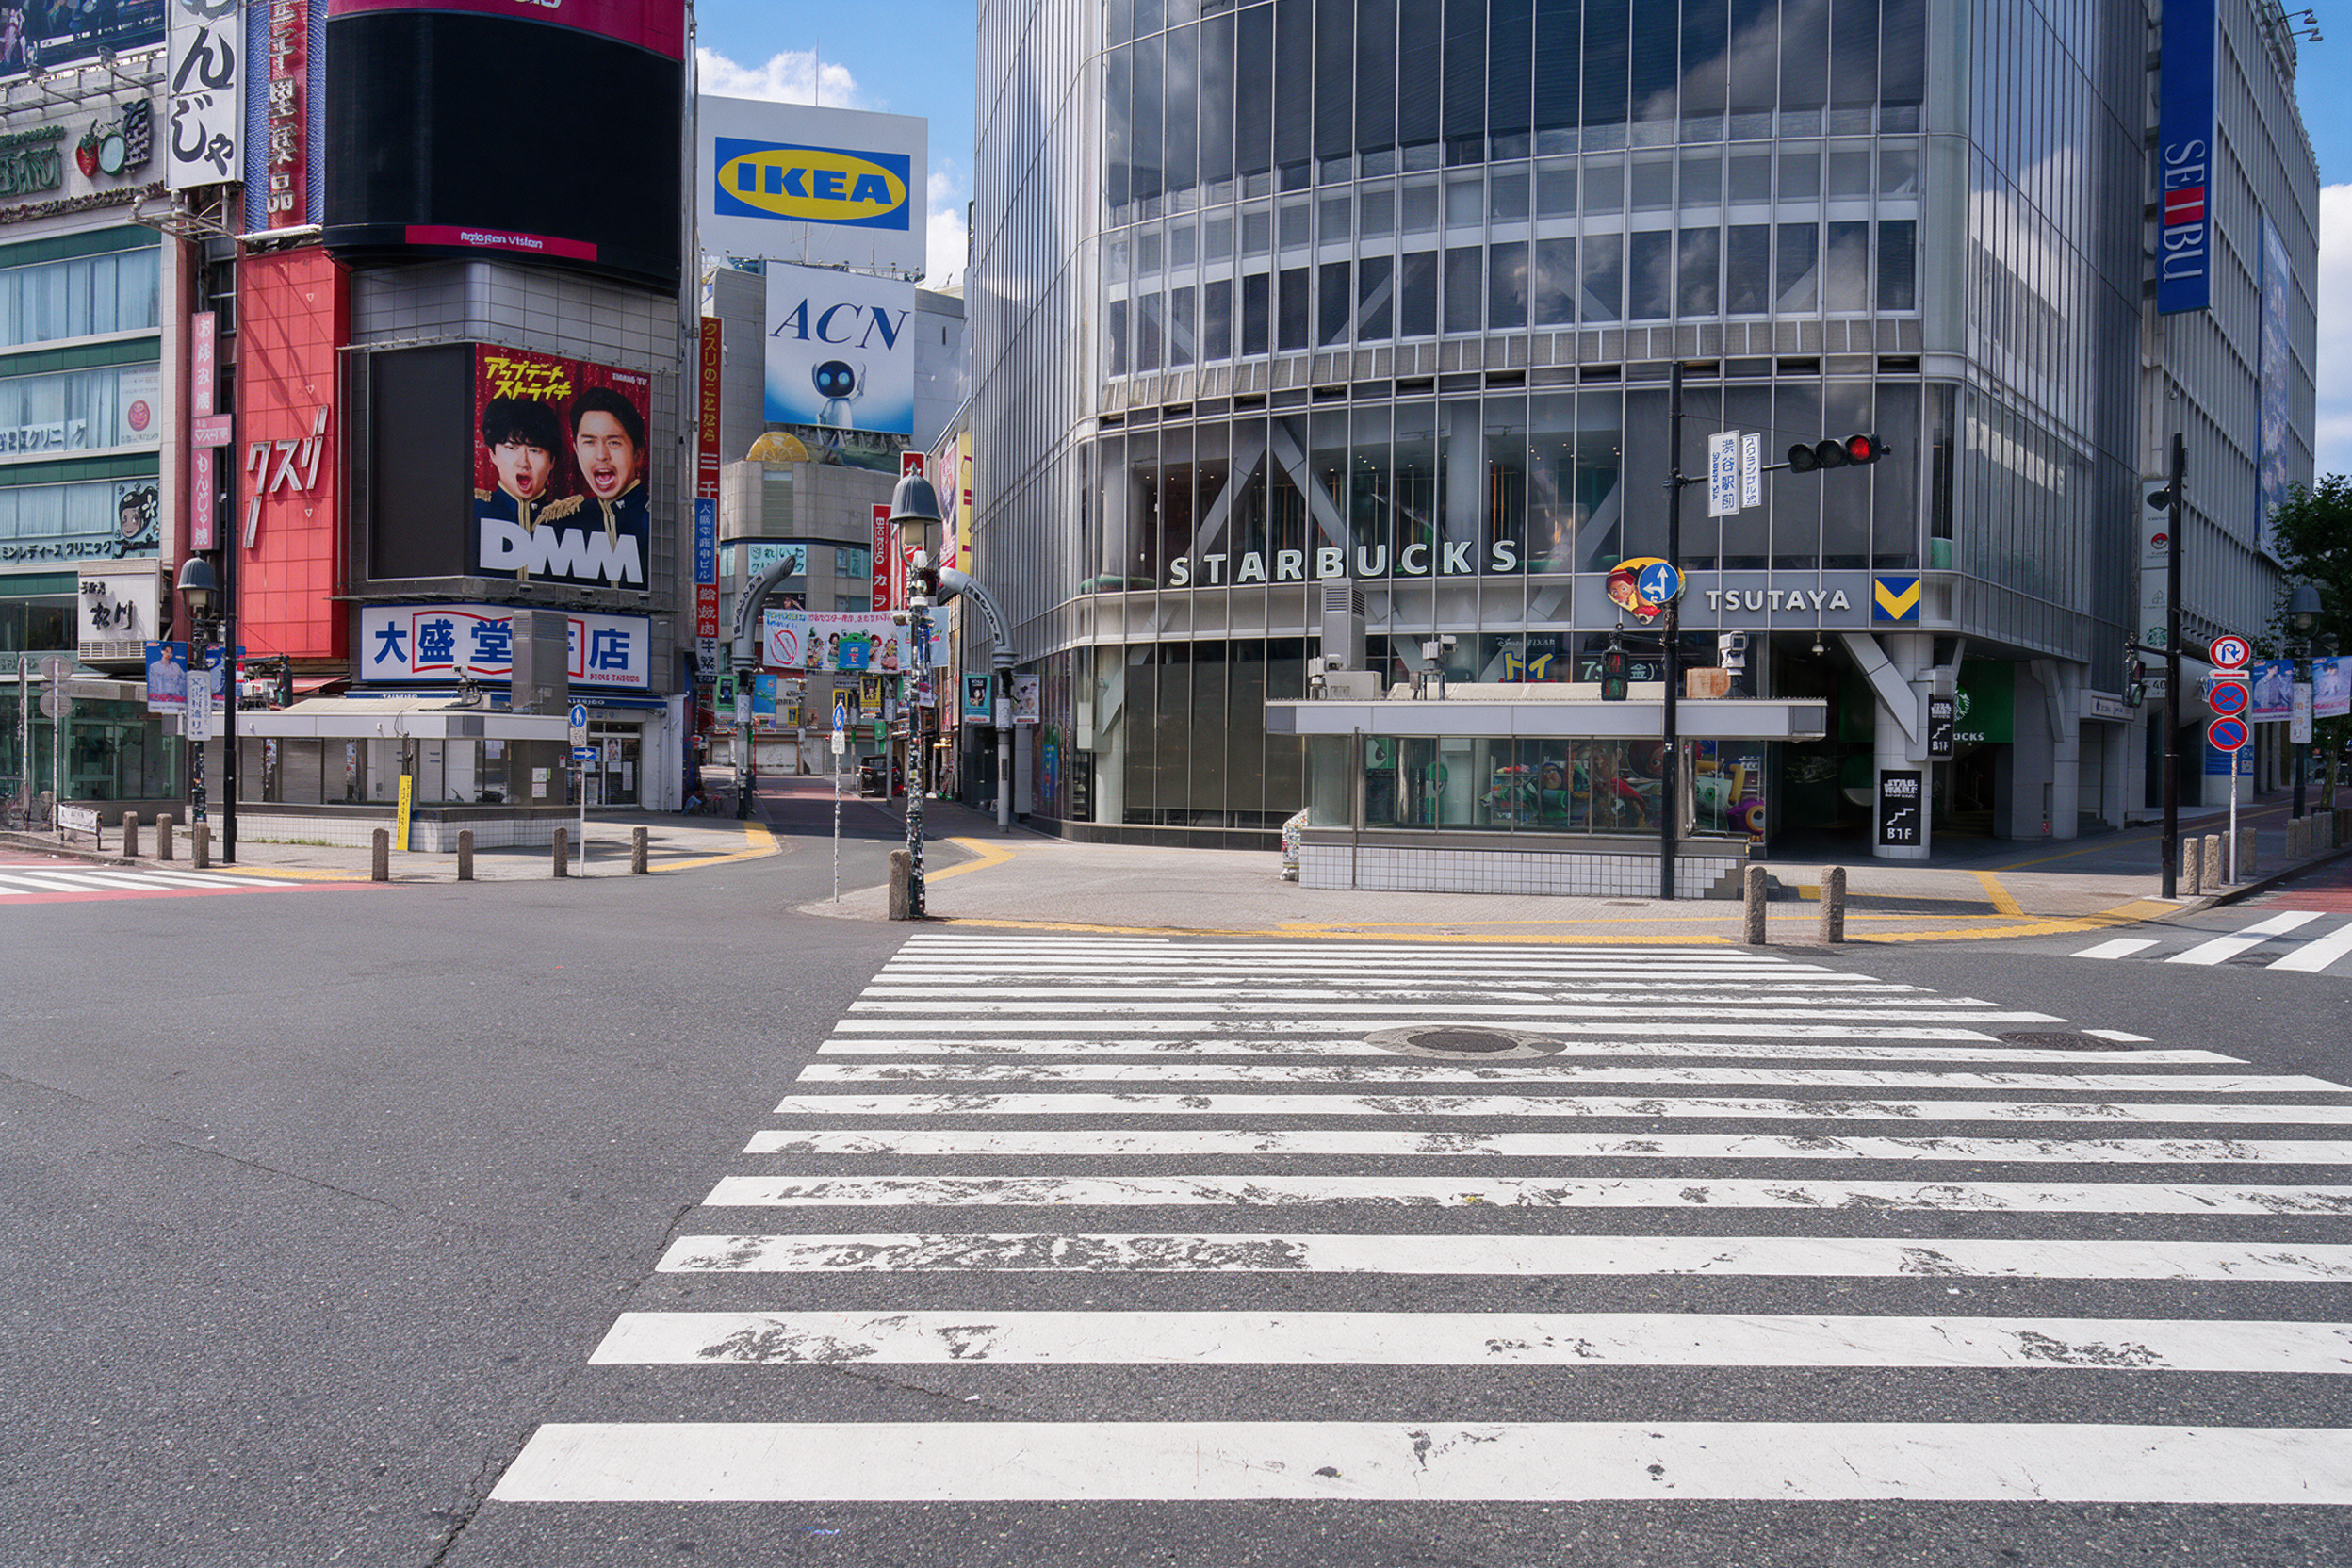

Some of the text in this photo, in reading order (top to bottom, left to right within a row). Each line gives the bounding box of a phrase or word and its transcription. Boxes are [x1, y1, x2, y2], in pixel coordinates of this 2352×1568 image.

[171, 0, 236, 177] んじゃ
[738, 162, 894, 205] IKEA
[2163, 139, 2206, 283] SEIBU
[769, 298, 911, 351] ACN
[484, 356, 564, 383] アップデート
[493, 380, 572, 401] ストライキ
[1721, 438, 1736, 510] 渋谷駅前
[480, 518, 644, 583] DMM
[1169, 539, 1517, 586] STARBUCKS
[1706, 589, 1850, 611] TSUTAYA
[374, 618, 630, 671] 大盛堂店
[1933, 741, 1949, 751] B1F
[1886, 827, 1913, 840] B1F
